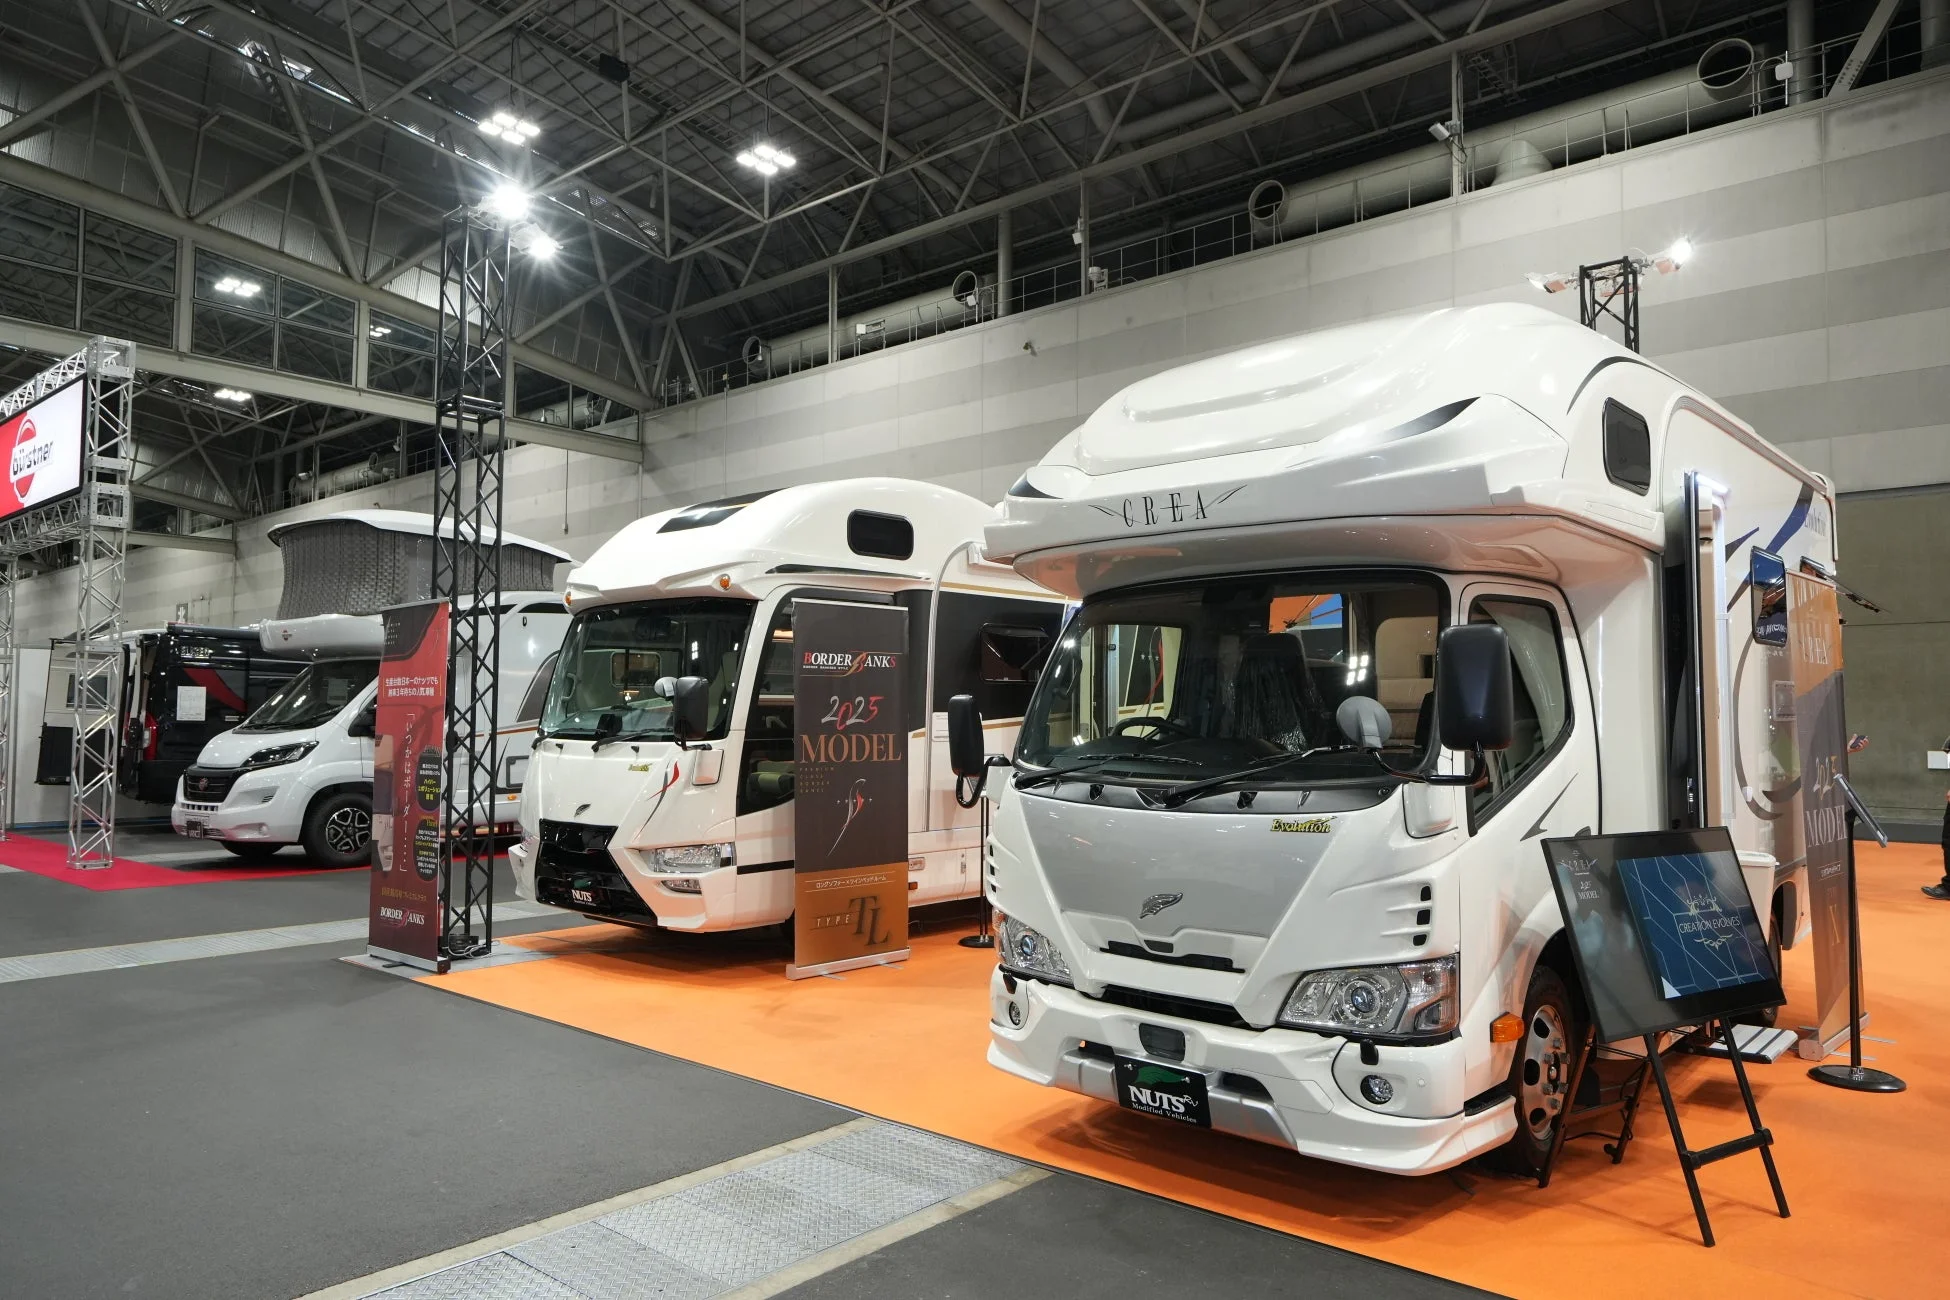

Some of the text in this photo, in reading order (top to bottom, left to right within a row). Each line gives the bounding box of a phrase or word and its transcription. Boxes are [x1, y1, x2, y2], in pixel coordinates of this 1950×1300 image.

[1122, 489, 1208, 528] CREA
[821, 695, 885, 731] 2025
[800, 732, 902, 764] MODEL
[1270, 817, 1335, 834] Evolution
[571, 889, 593, 902] NUTS
[816, 914, 851, 928] TYPE
[1679, 915, 1741, 934] CREATION EVOLVES
[1128, 1085, 1186, 1113] NUTS
[1131, 1102, 1197, 1124] Modified Vehicles
